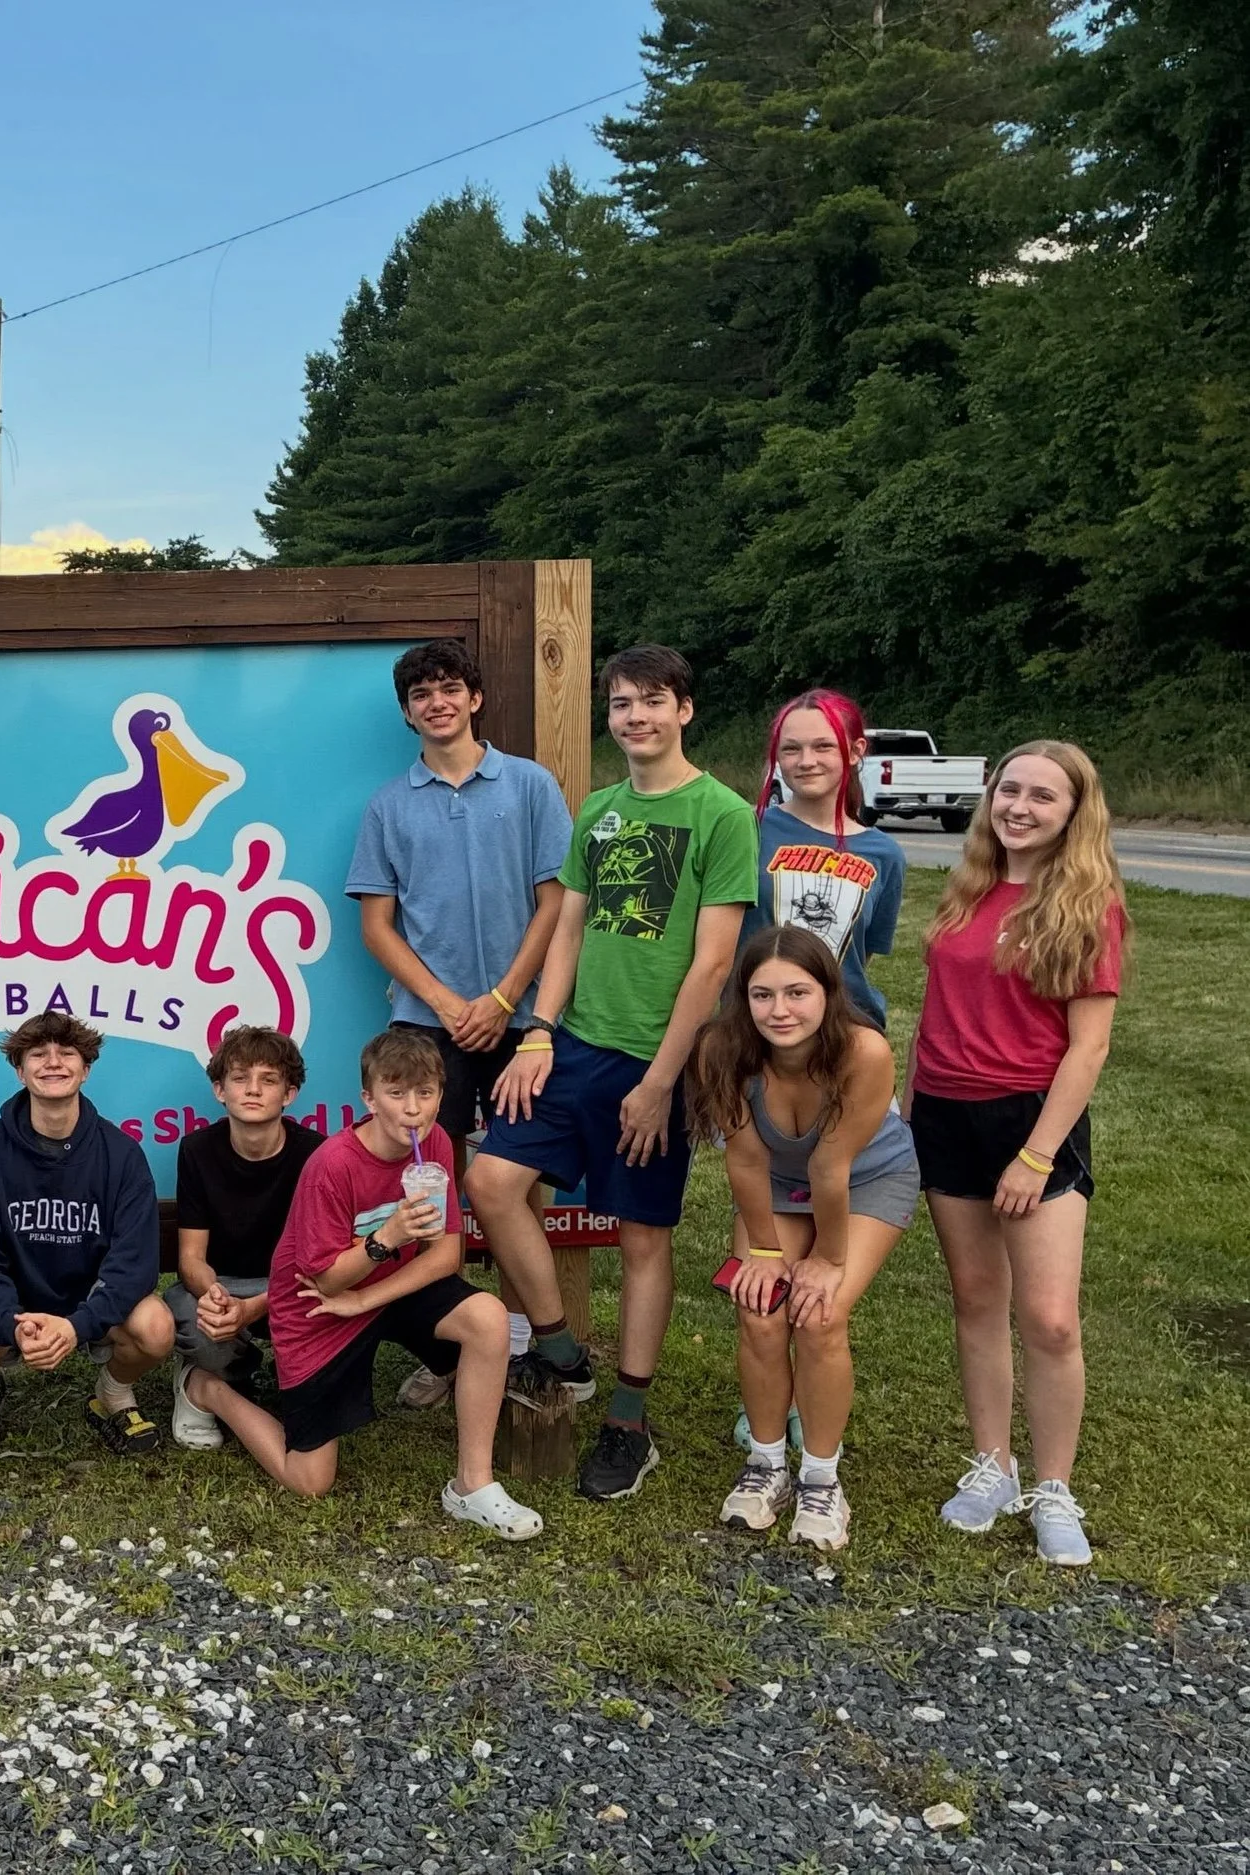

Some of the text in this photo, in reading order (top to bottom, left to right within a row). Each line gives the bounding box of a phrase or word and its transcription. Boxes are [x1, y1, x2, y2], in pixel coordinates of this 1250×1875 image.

[8, 1199, 100, 1235] GEORGIA
[29, 1233, 82, 1244] PEACH STATE
